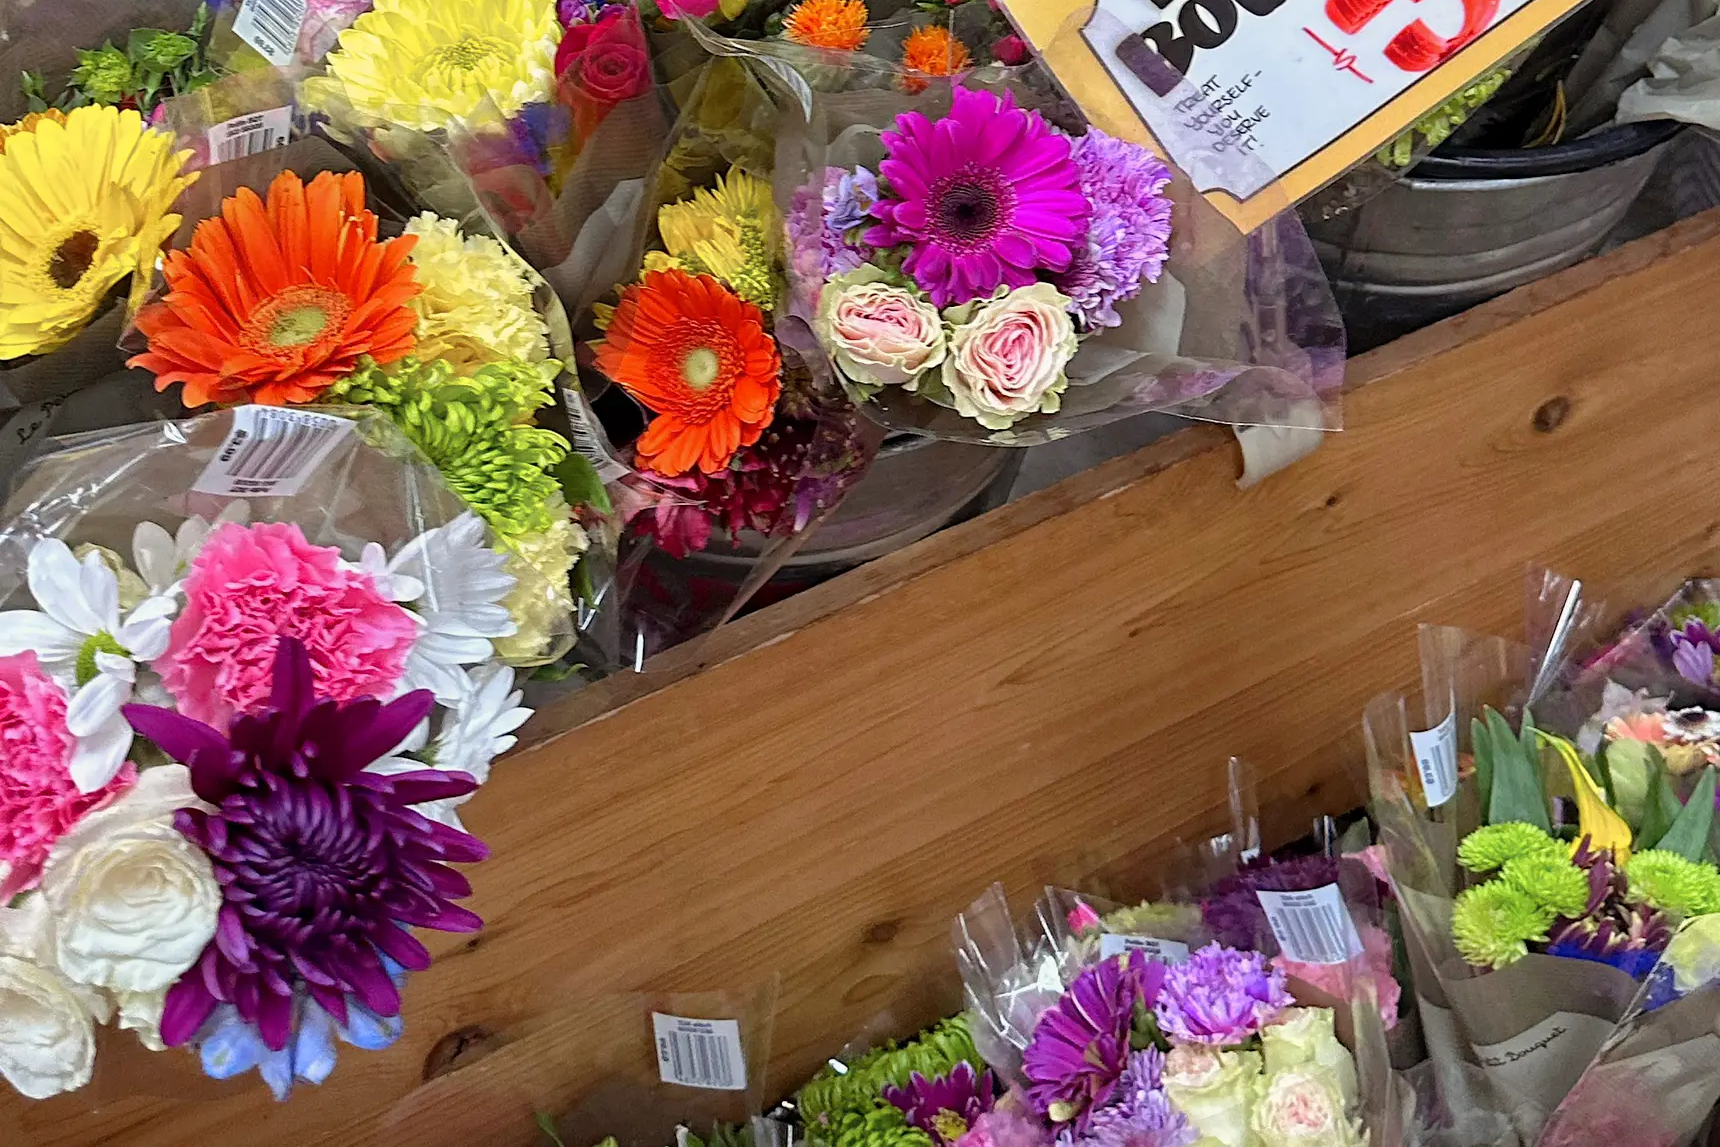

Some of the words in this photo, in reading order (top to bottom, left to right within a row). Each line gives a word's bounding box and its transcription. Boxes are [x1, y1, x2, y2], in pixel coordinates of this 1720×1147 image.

[1173, 74, 1222, 115] TREAT
[1207, 109, 1243, 136] YOU
[1212, 105, 1271, 153] DESERVE
